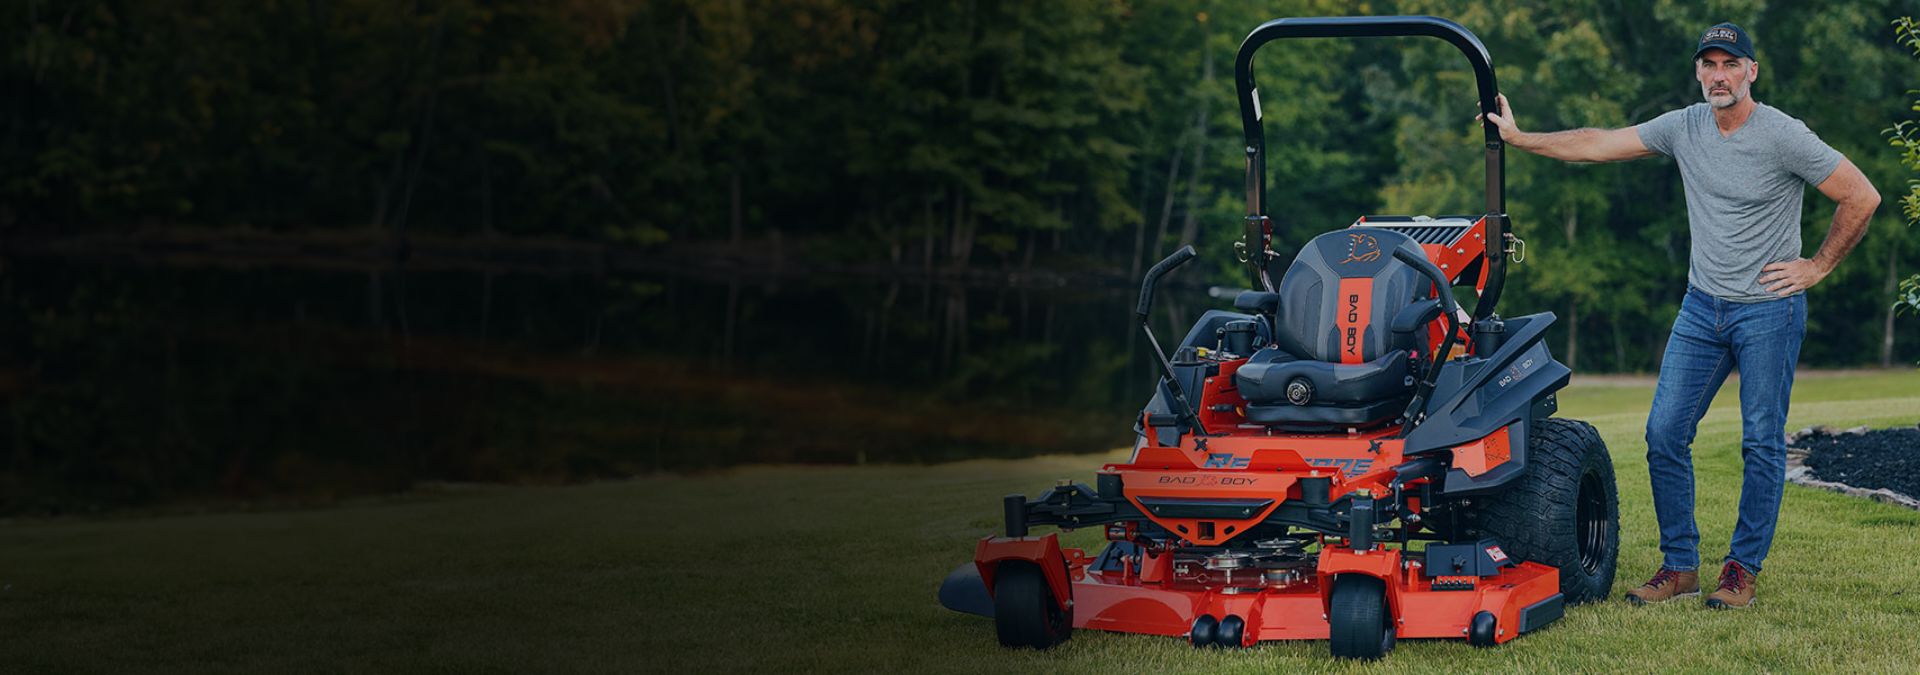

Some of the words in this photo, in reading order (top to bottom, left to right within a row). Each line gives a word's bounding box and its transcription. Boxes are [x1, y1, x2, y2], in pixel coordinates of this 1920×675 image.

[1349, 294, 1359, 323] BAD
[1347, 327, 1357, 356] BOY
[1159, 475, 1196, 484] BAD
[1220, 476, 1258, 486] BOY
